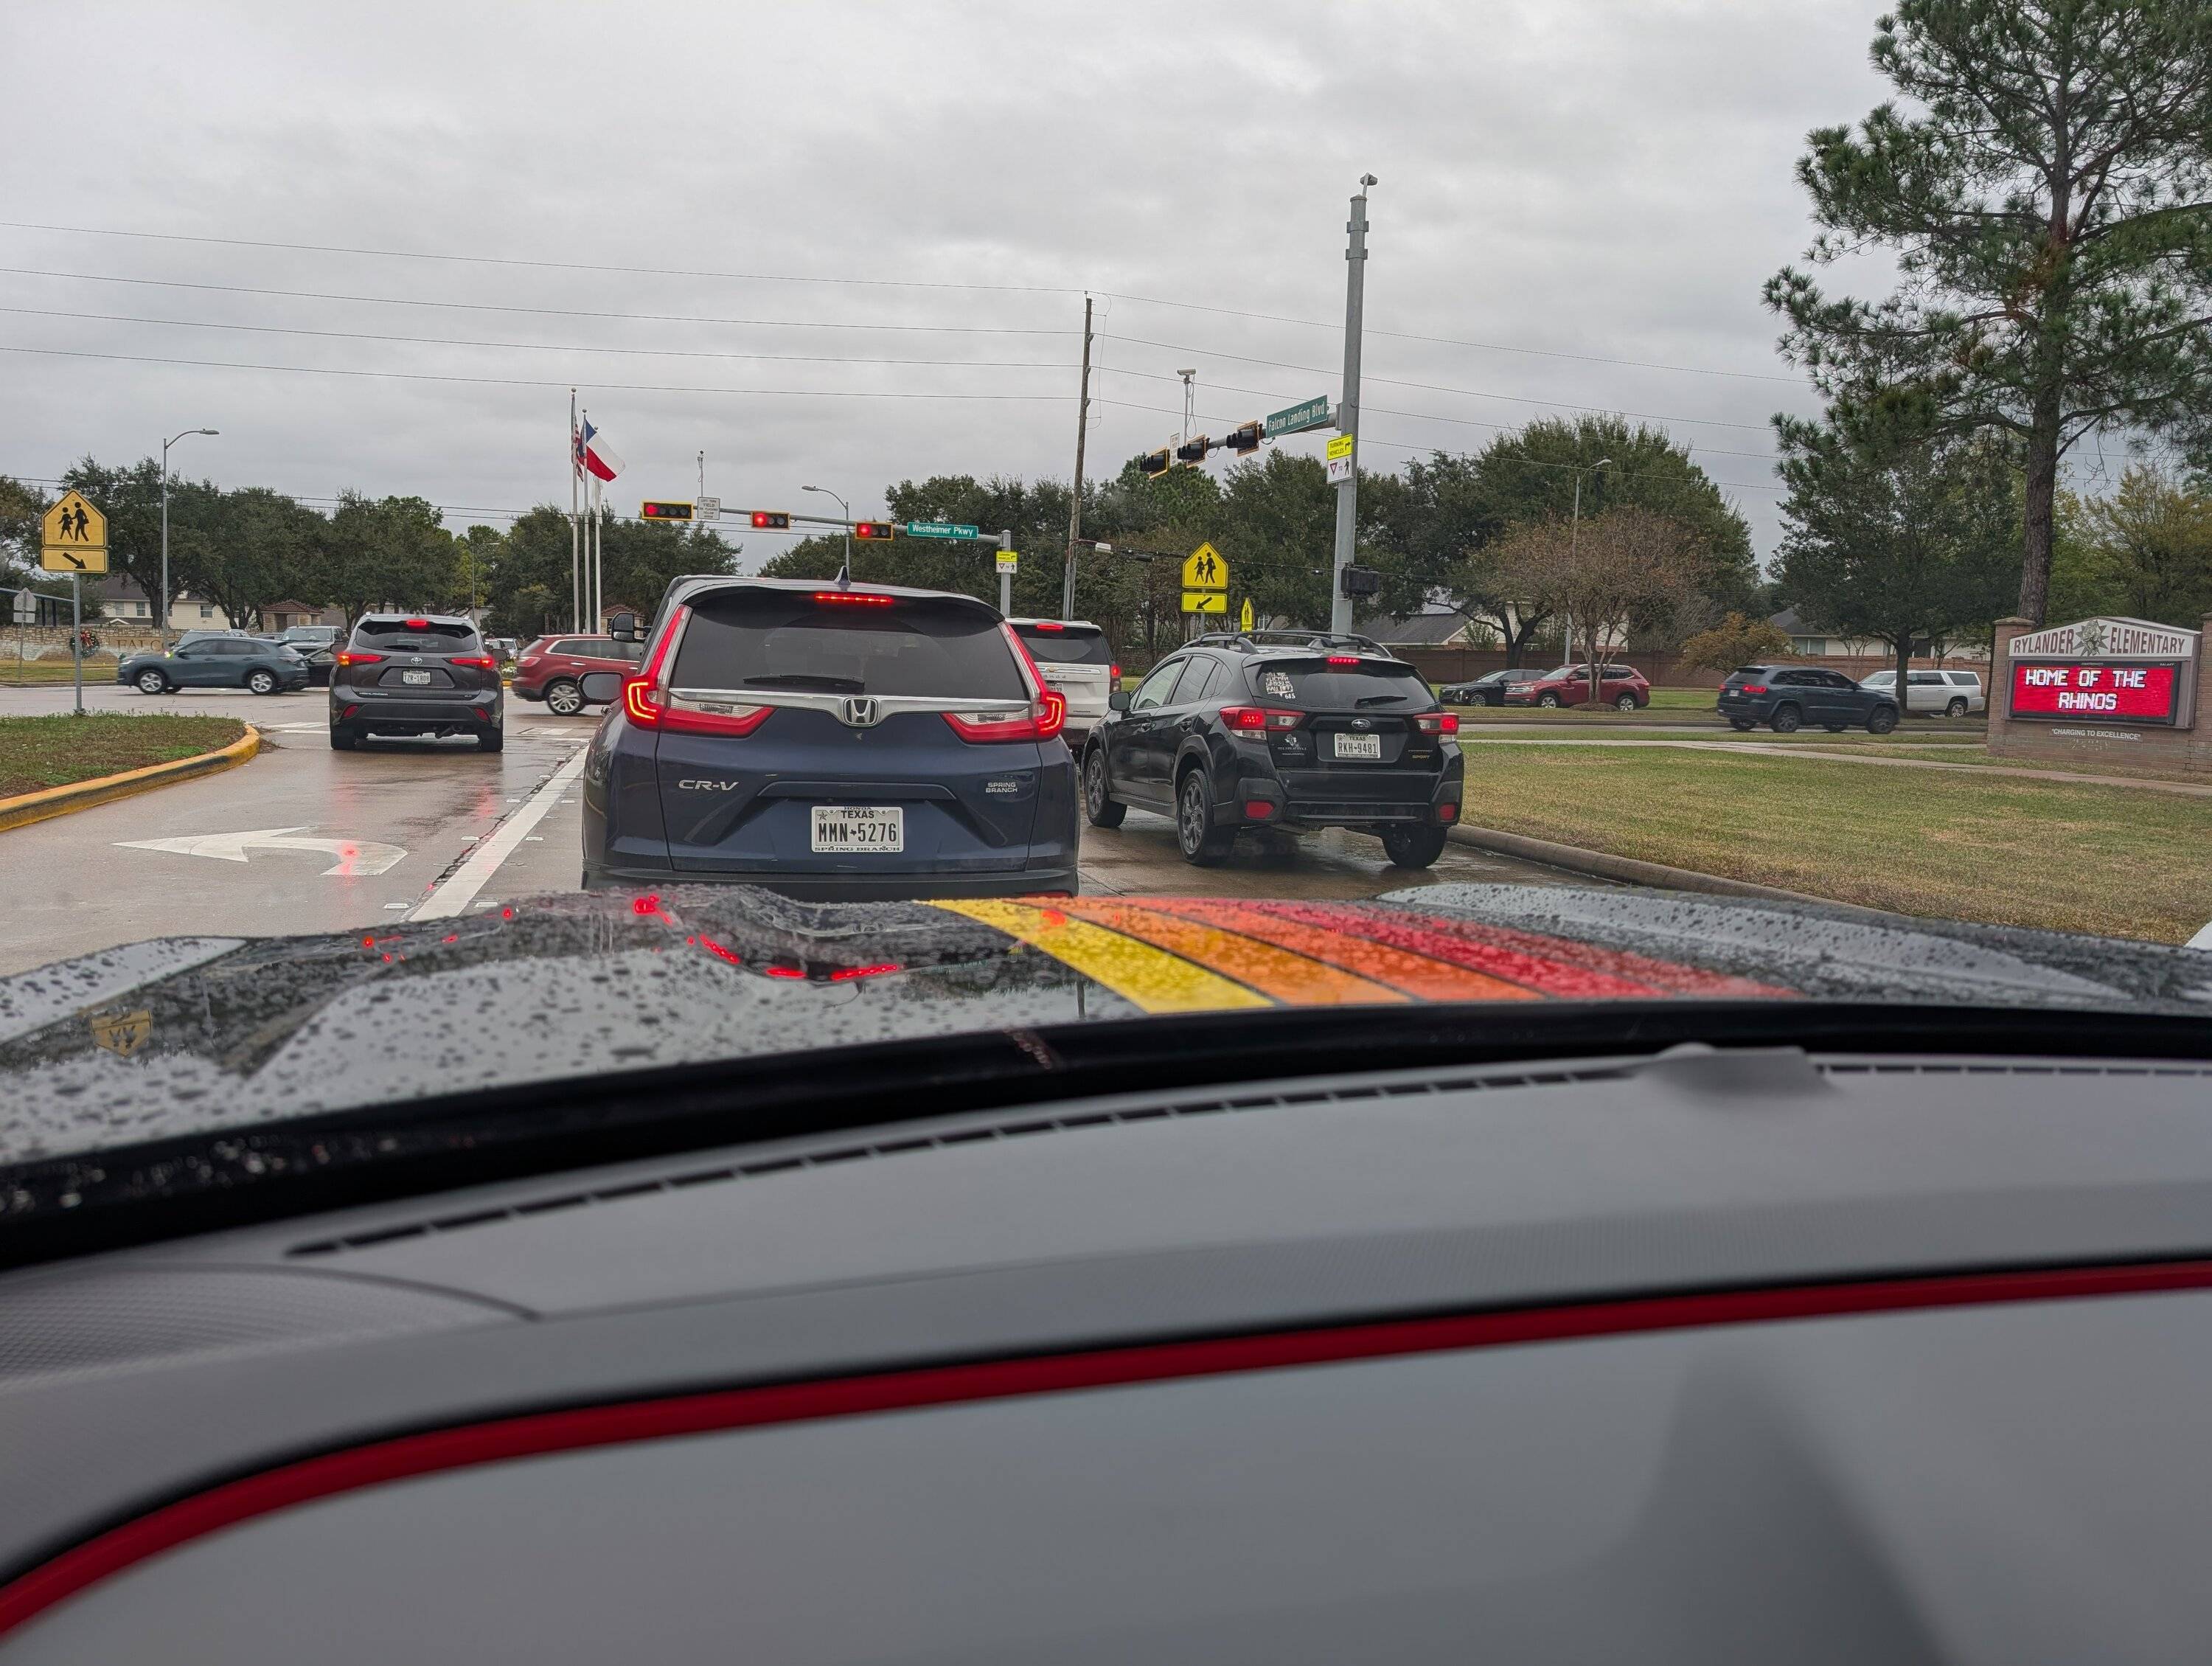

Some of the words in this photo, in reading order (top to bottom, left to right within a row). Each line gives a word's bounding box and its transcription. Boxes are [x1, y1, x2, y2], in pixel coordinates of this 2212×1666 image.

[1268, 417, 1286, 431] Falcon
[1287, 409, 1310, 423] Landing
[1312, 401, 1325, 417] Blvd
[1329, 448, 1344, 456] VEHICLES
[912, 524, 951, 534] Westheimer
[953, 527, 973, 537] Pkwy
[2014, 629, 2074, 654] RYLANDER
[2110, 628, 2185, 654] ELEMENTARY
[2025, 669, 2069, 686] HOME
[2079, 670, 2101, 687] OF
[2112, 670, 2146, 687] THE
[2058, 692, 2117, 710] RHINOS
[2052, 729, 2085, 737] "CHARGING
[2096, 730, 2141, 740] EXCELLENCE"
[678, 780, 739, 791] CR-V
[841, 811, 875, 819] TEXAS
